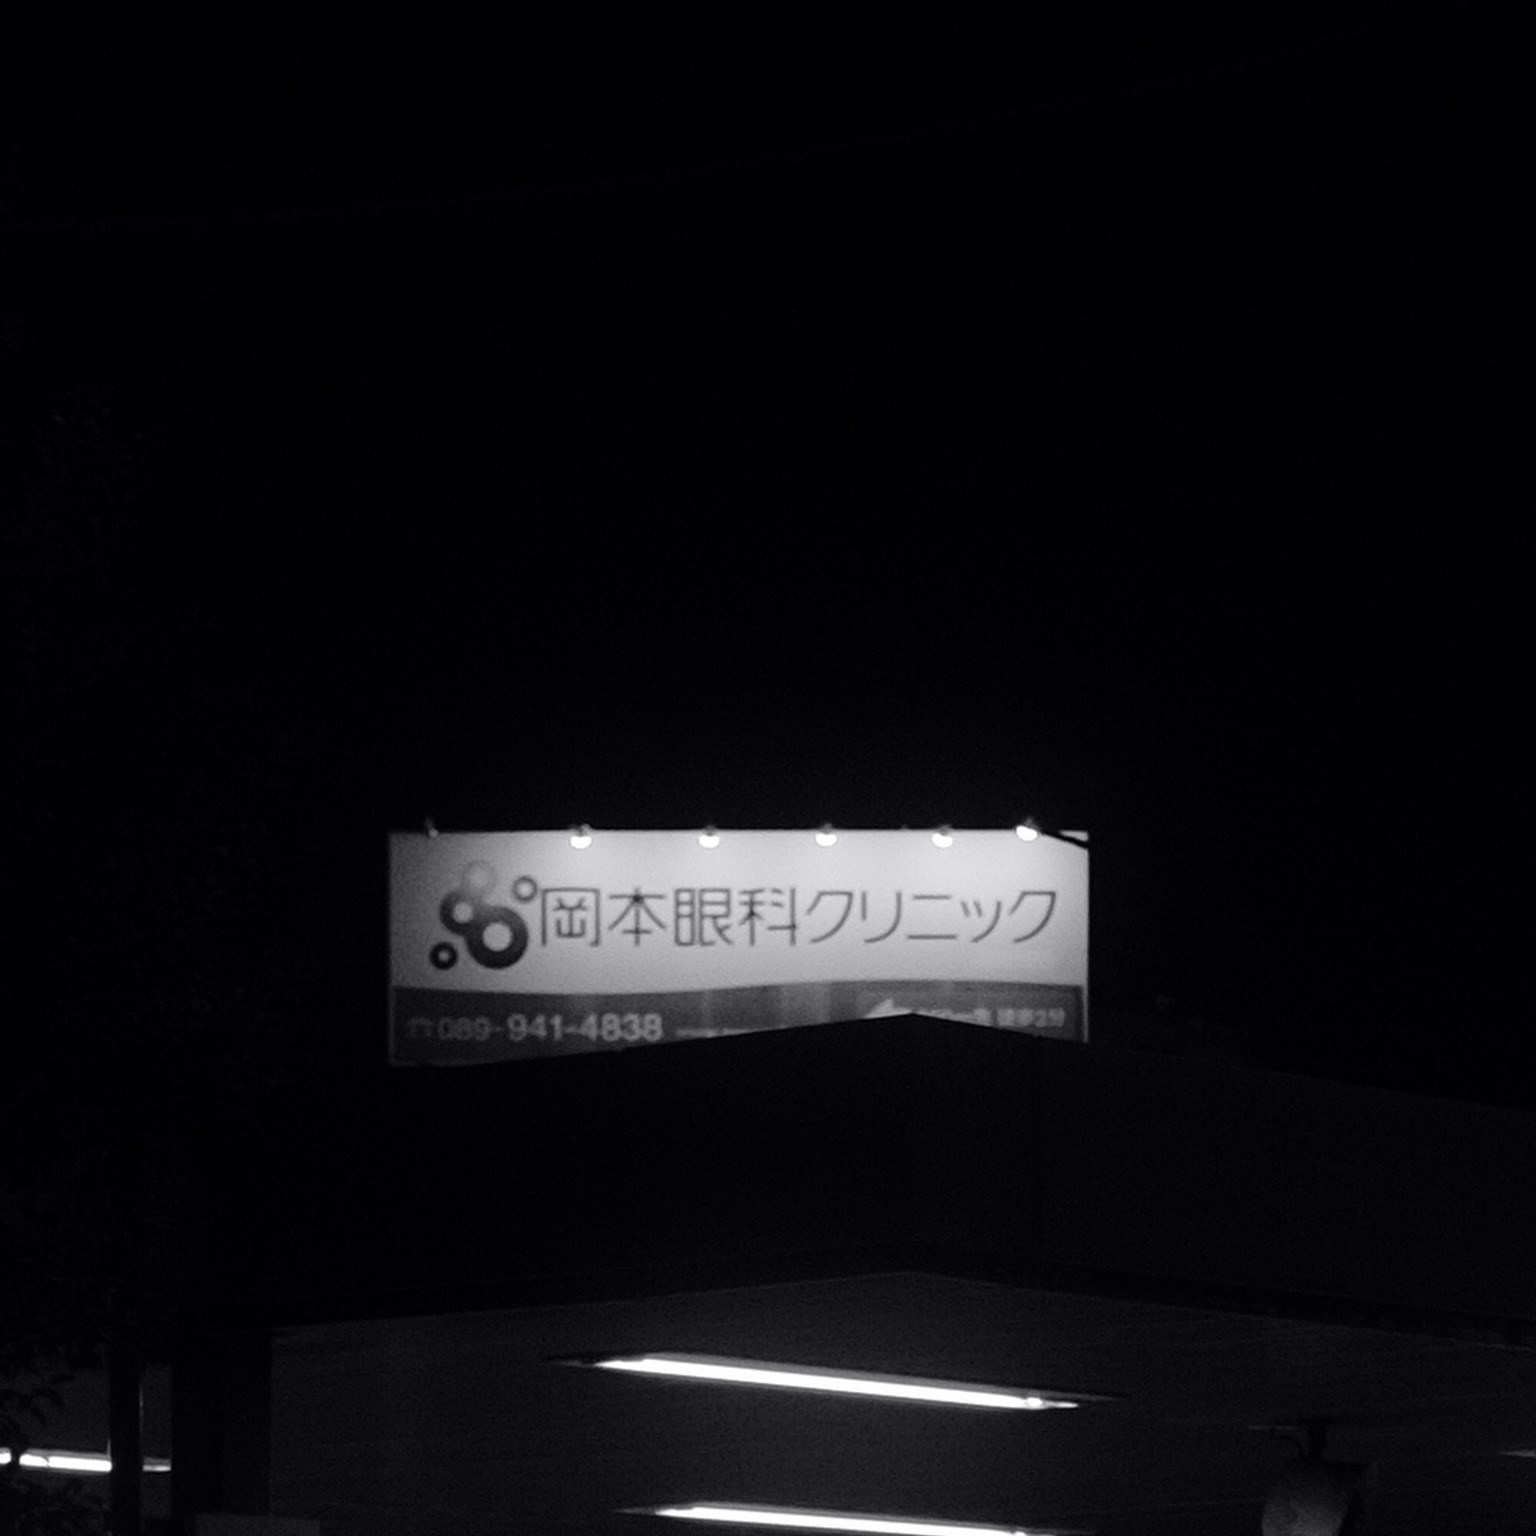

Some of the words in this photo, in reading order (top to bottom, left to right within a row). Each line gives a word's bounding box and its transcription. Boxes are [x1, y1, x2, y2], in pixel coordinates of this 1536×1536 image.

[540, 886, 1058, 947] 岡本眼科クリニック
